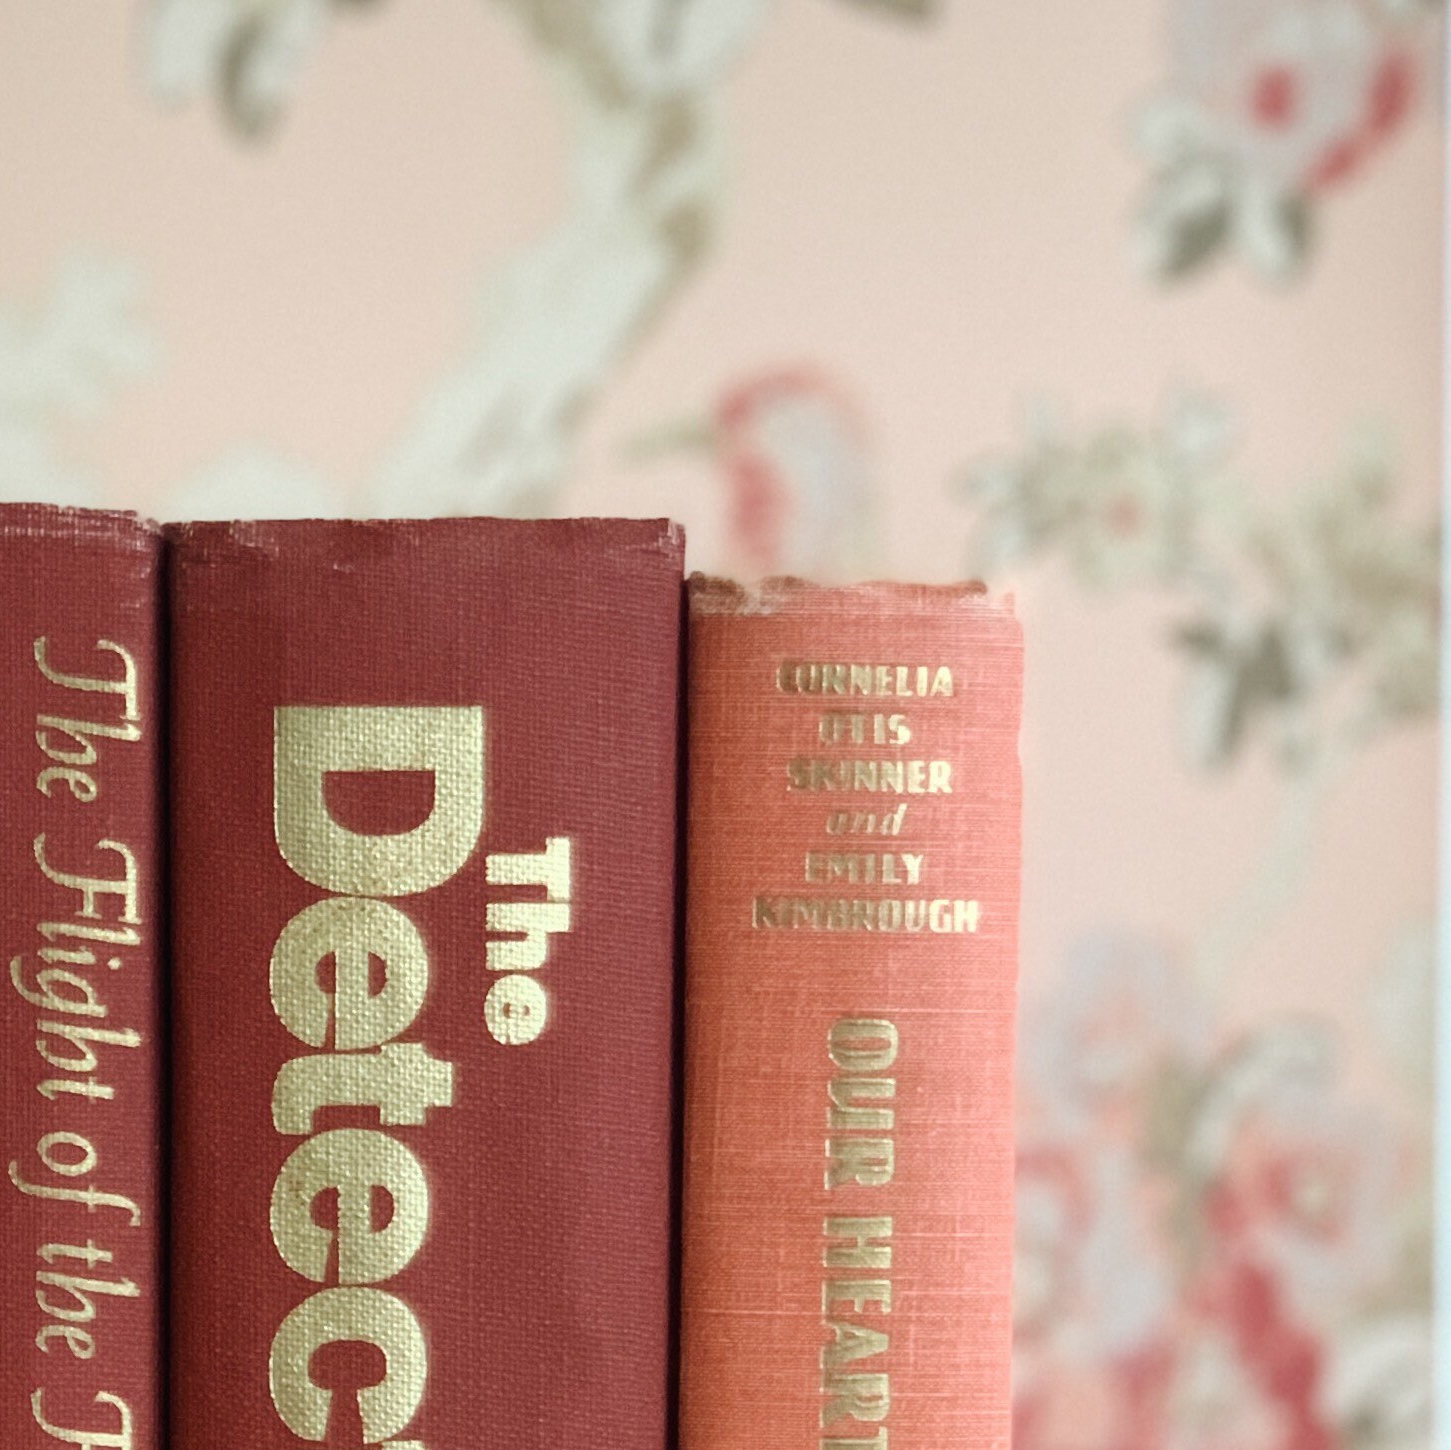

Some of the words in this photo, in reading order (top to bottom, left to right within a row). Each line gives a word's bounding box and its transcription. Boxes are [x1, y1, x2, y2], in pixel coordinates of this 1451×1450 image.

[33, 636, 142, 804] The
[775, 663, 956, 698] CORNELIA
[786, 758, 954, 794] SKINNER
[825, 803, 908, 836] and
[804, 852, 925, 885] EMILY
[9, 833, 142, 1101] Flight
[484, 836, 572, 1046] The
[824, 1017, 899, 1190] OUR
[8, 1130, 143, 1227] of
[34, 1238, 142, 1356] the
